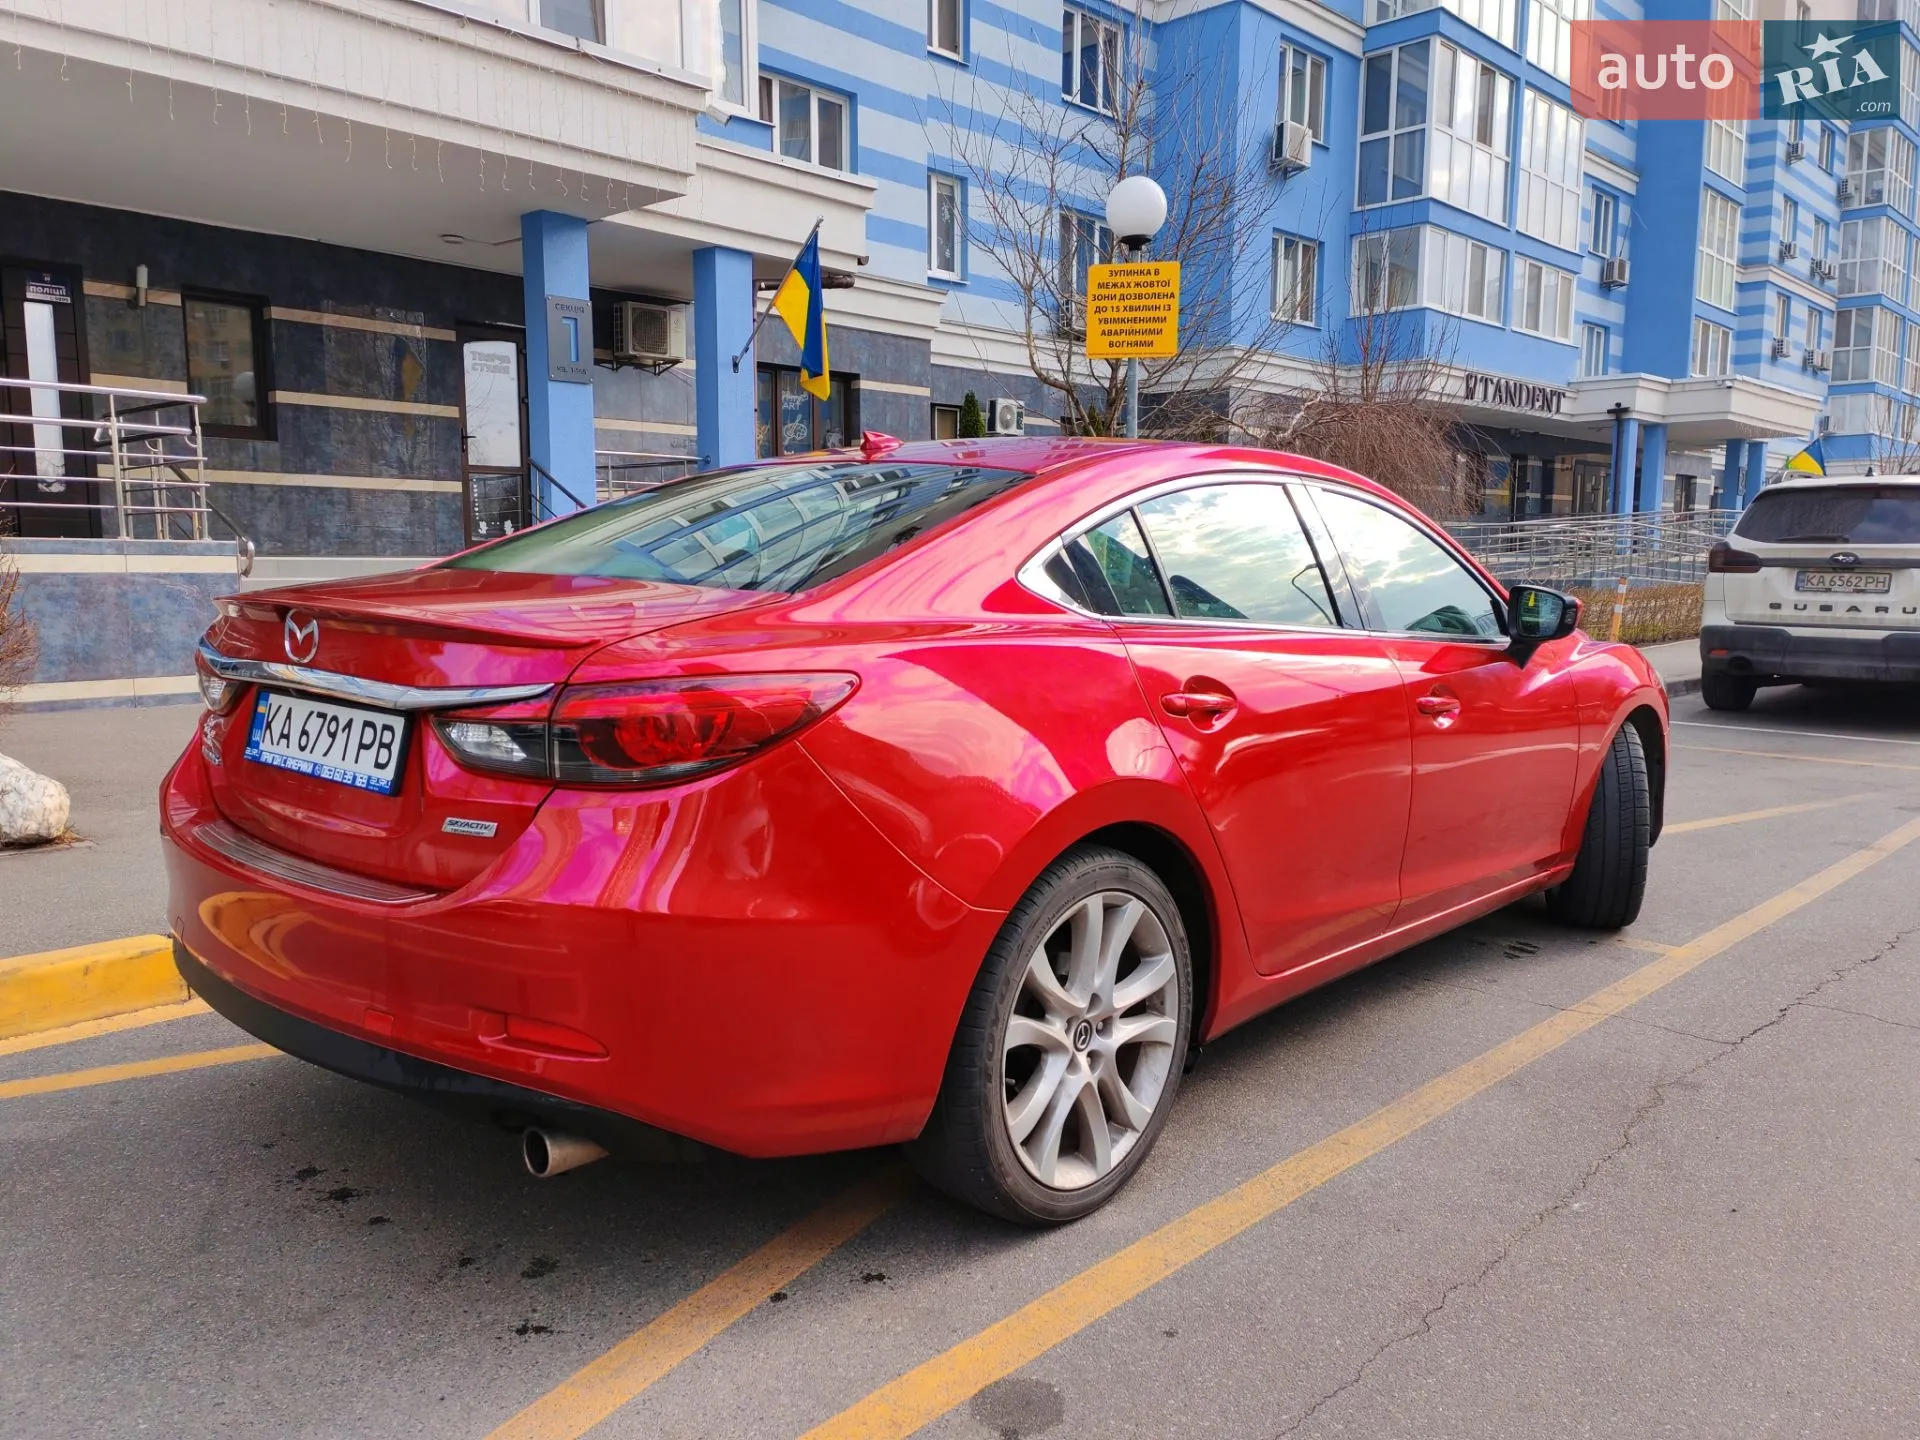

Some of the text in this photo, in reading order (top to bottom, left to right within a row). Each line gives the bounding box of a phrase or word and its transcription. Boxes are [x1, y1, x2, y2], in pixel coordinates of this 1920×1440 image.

[1108, 268, 1160, 277] ЗУПИНКА В
[1097, 279, 1171, 289] МЕЖАХ ЖОВТОЇ
[1091, 292, 1175, 302] ЗОНИ ДОЗВОЛЕНА
[1094, 305, 1108, 314] ДО
[1122, 304, 1161, 312] ХВИЛИН
[1163, 304, 1171, 312] ІЗ
[1098, 316, 1167, 325] УВІМКНЕНИМИ
[1101, 327, 1163, 336] АВАРІЙНИМИ
[561, 315, 579, 362] 1
[1108, 340, 1154, 348] ВОГНЯМИ
[1805, 575, 1887, 588] KA 6562 PH
[1769, 602, 1918, 614] SUBARU
[252, 728, 261, 741] UA
[262, 703, 292, 749] KA
[298, 710, 353, 762] 6791
[354, 720, 396, 770] PB
[447, 819, 491, 830] SKYACTIV
